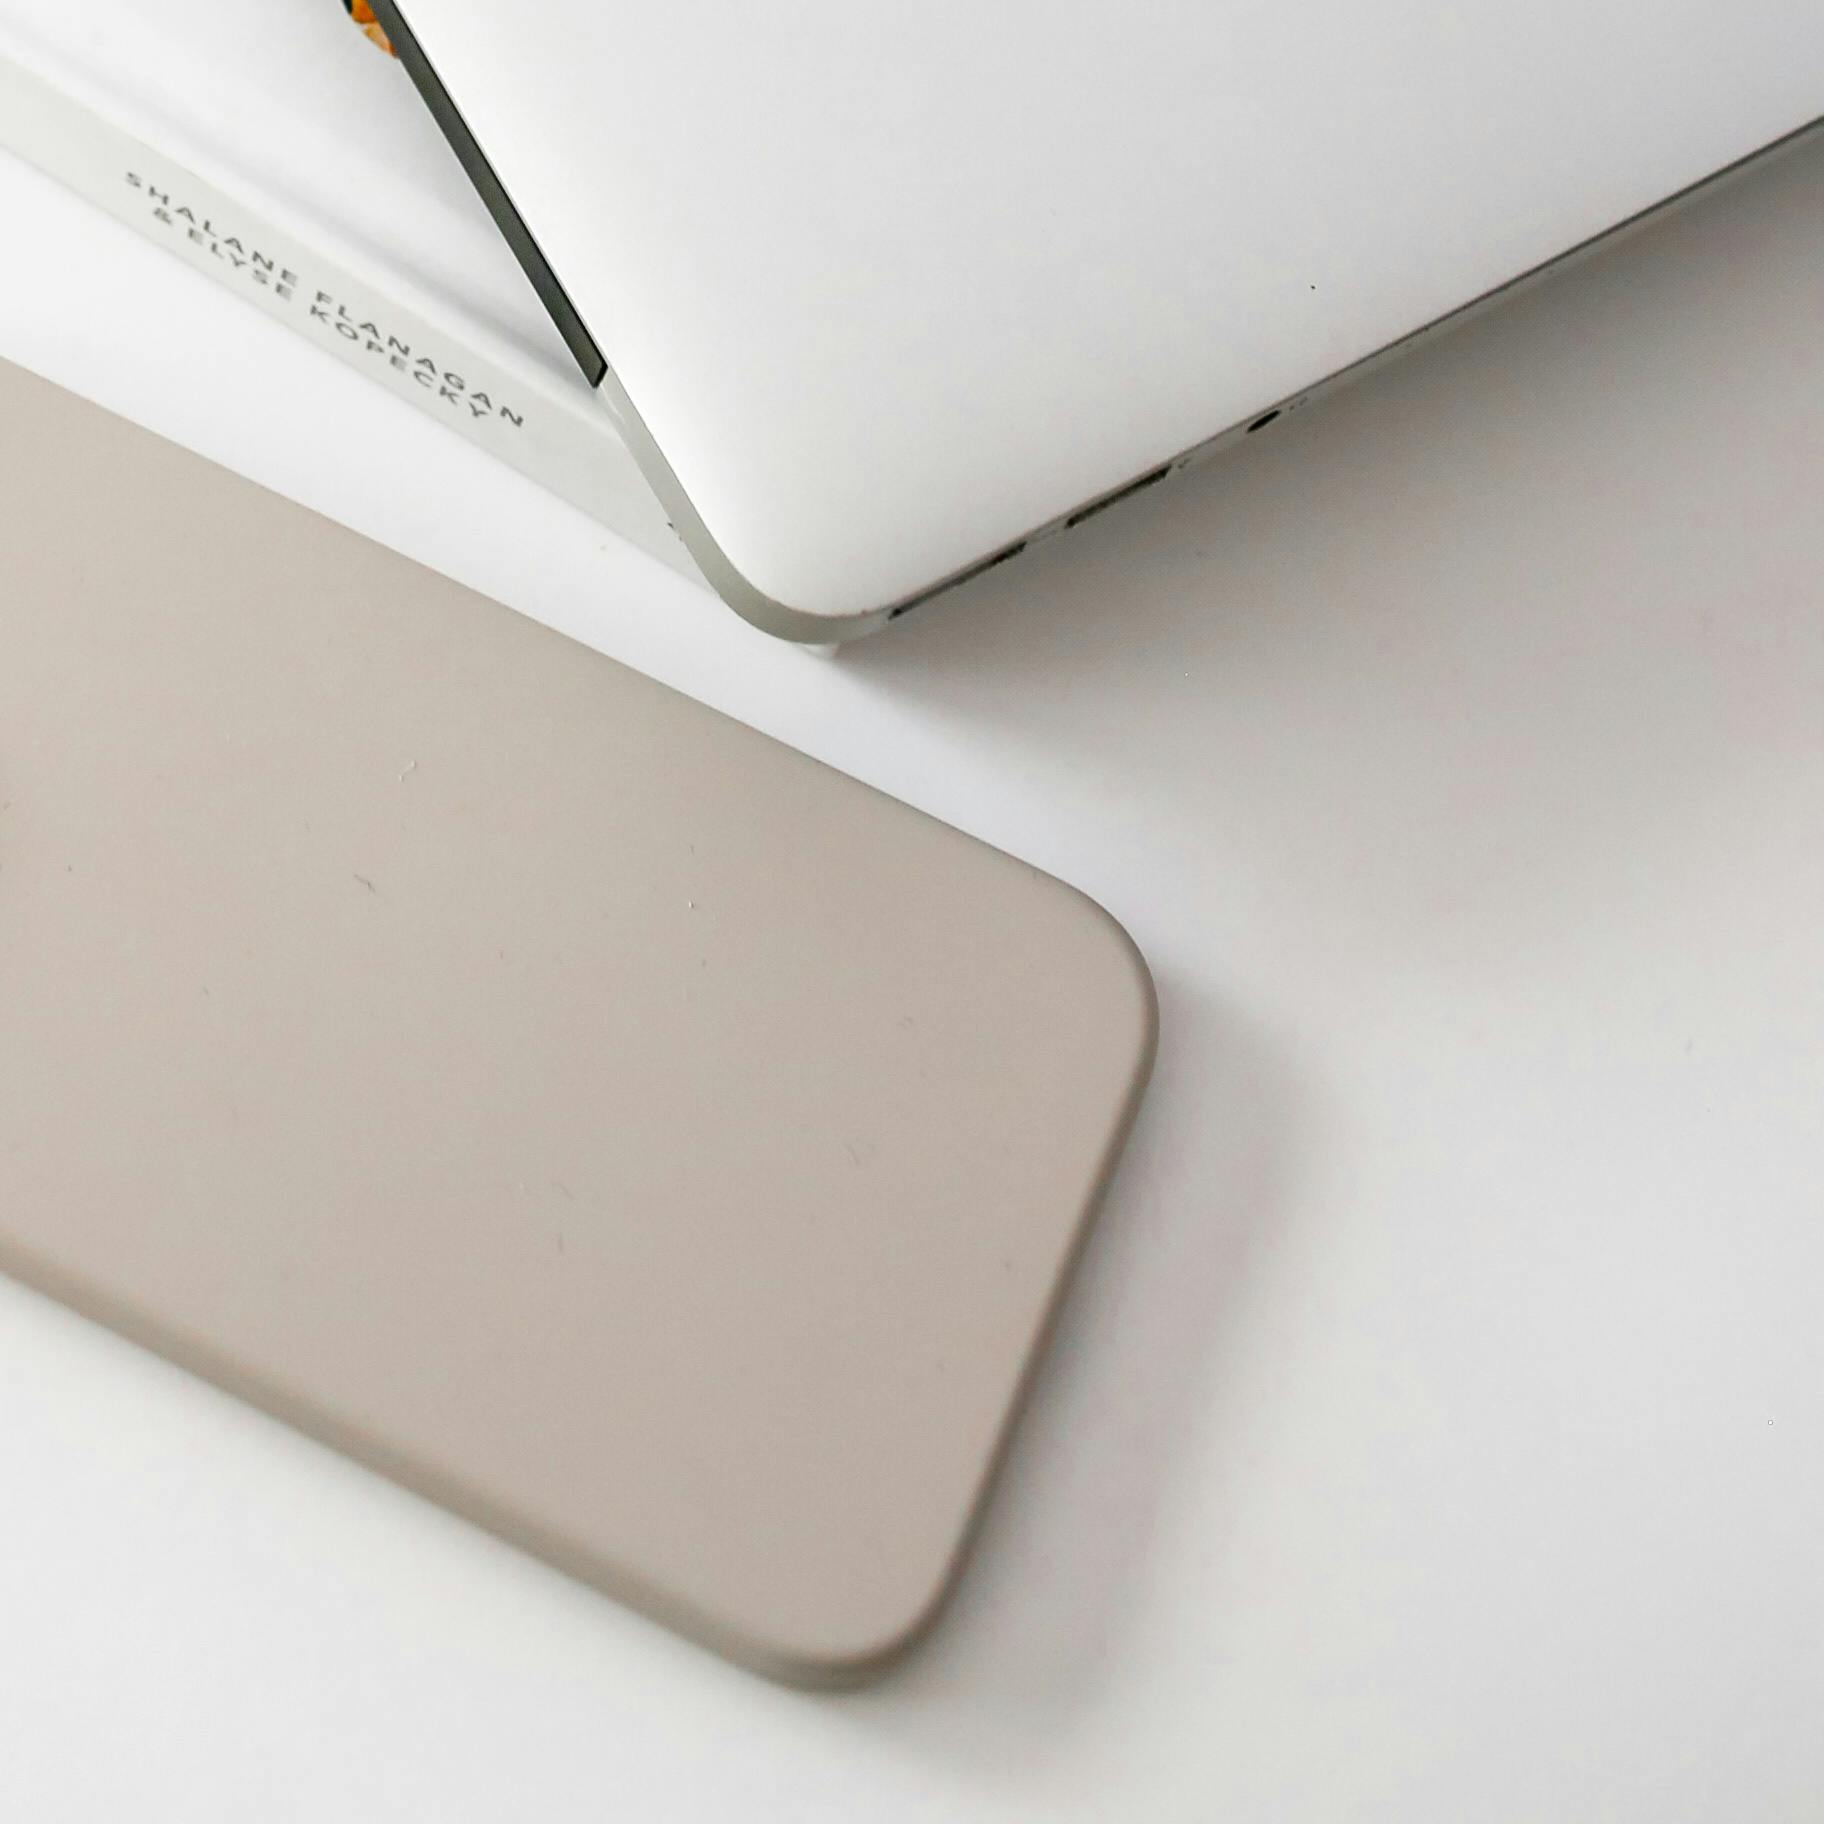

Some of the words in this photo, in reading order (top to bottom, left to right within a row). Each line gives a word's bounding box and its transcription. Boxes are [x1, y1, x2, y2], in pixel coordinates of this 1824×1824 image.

[125, 171, 299, 285] SHALANE
[314, 291, 525, 428] FLANAGAN
[152, 206, 172, 226] &
[187, 227, 294, 301] ELYSE
[310, 305, 490, 418] KOPECKY
